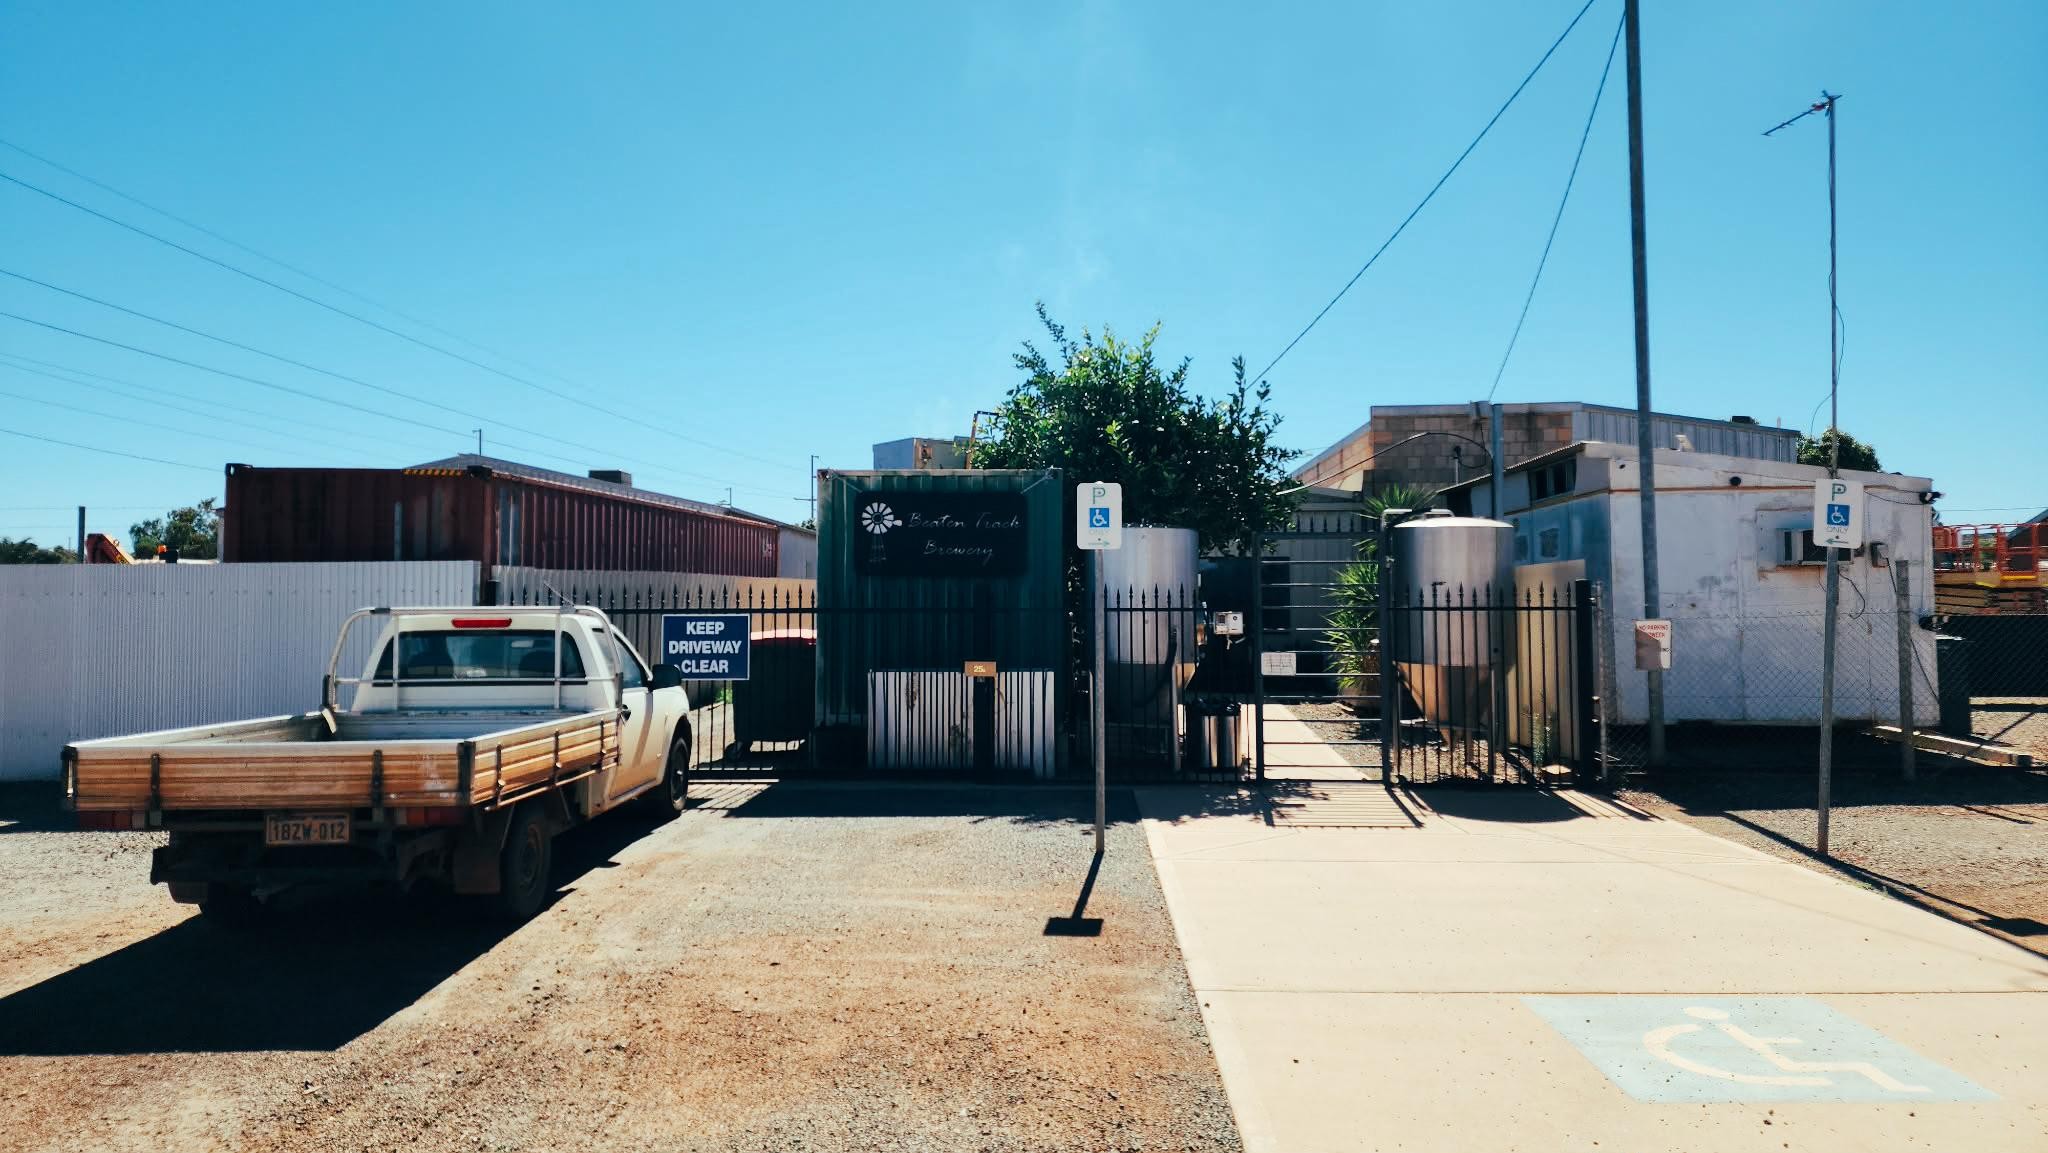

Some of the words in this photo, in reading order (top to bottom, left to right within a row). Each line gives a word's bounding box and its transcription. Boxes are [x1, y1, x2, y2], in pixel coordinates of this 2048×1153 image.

[1092, 487, 1106, 504] P
[1832, 483, 1847, 501] P
[908, 512, 965, 528] Beaten
[975, 512, 1022, 528] Track
[1825, 527, 1849, 535] ONLY
[923, 539, 993, 566] Brewery
[686, 621, 725, 635] KEEP
[668, 640, 742, 654] DRIVEWAY
[681, 659, 729, 673] CLEAR
